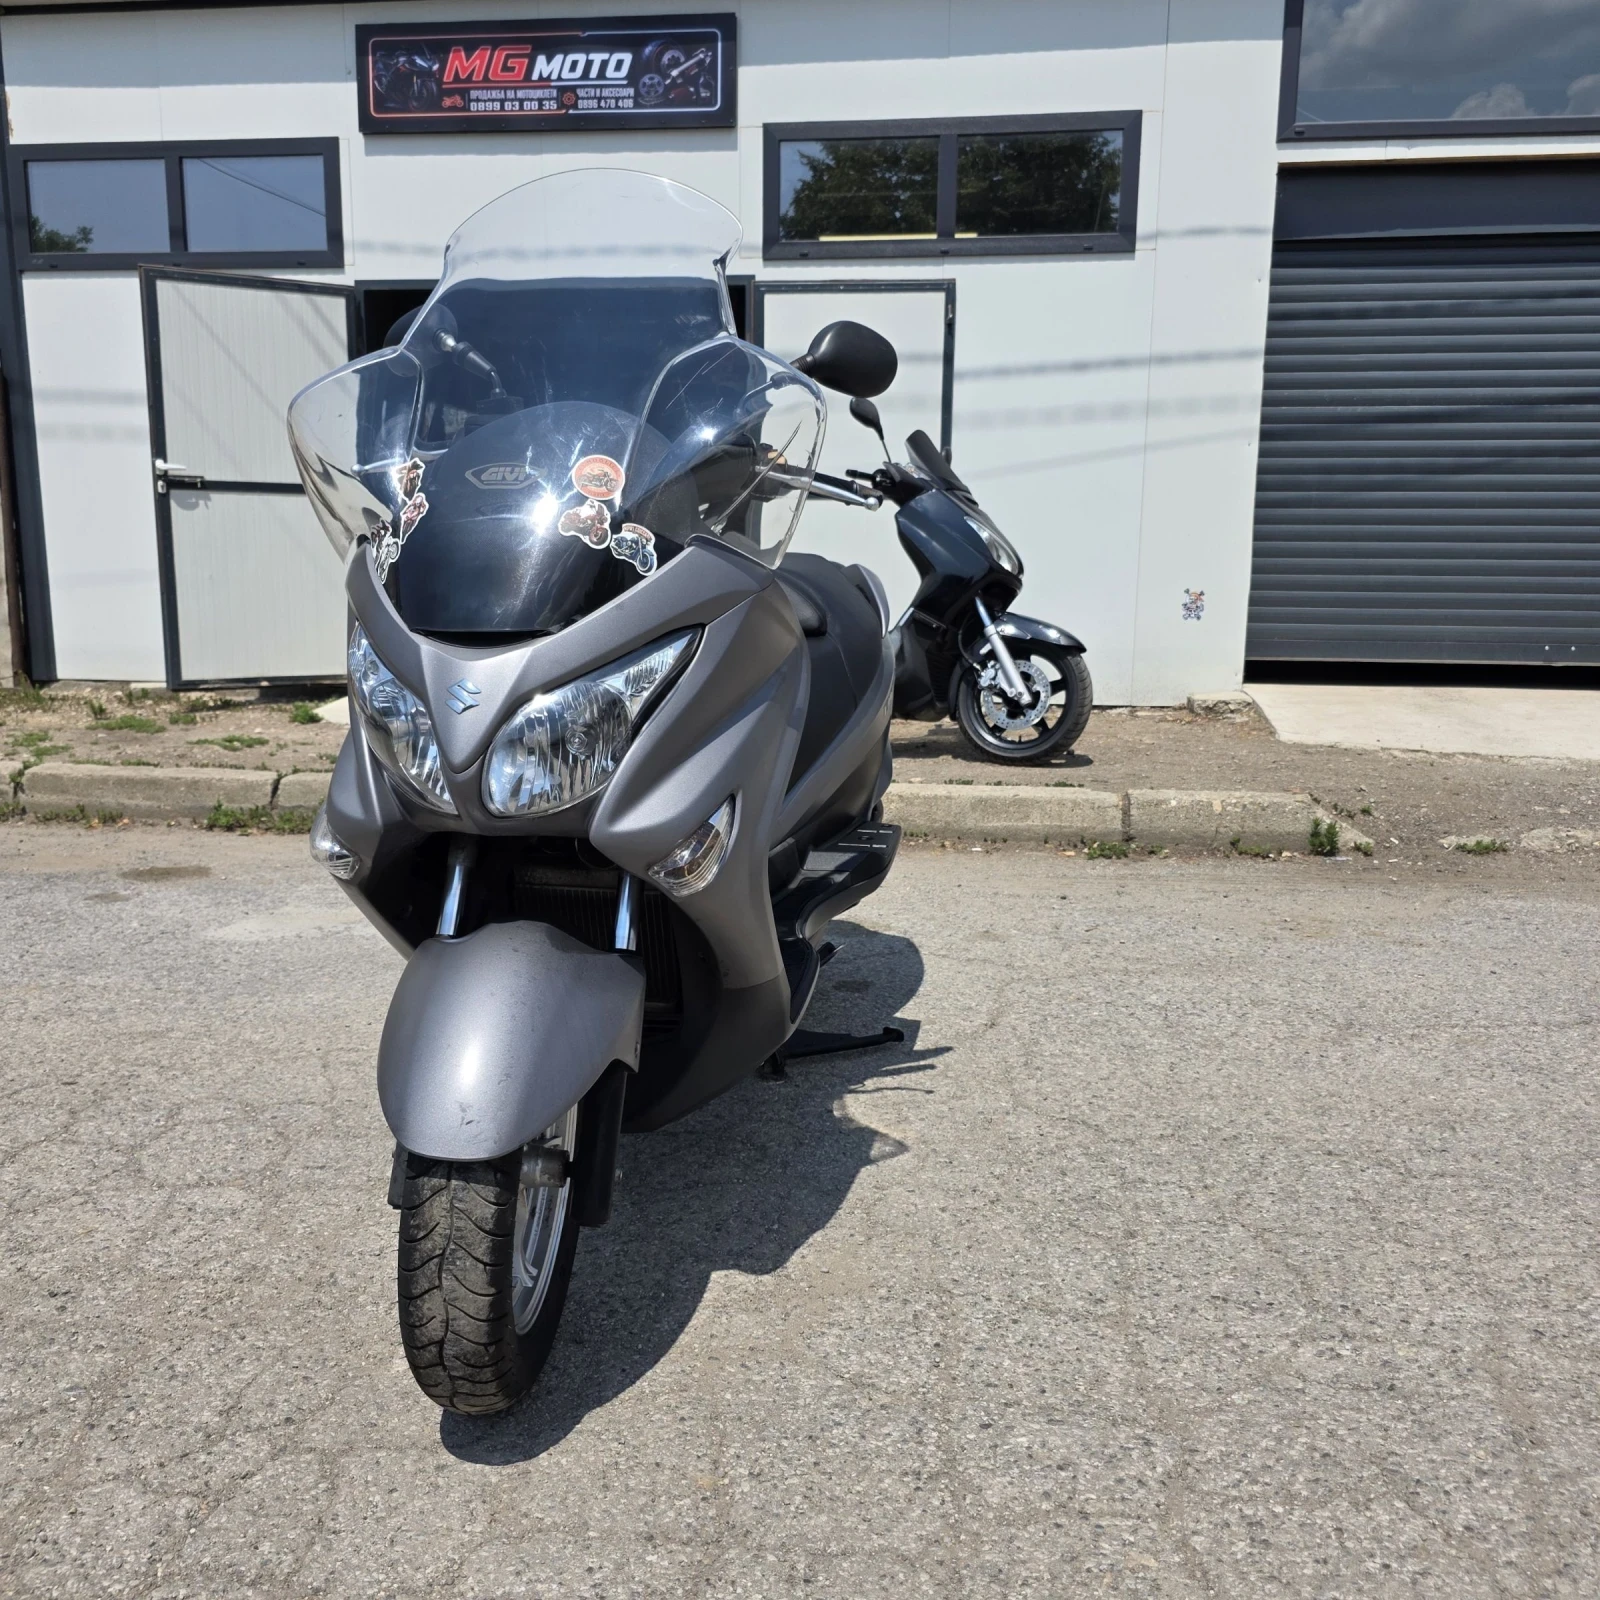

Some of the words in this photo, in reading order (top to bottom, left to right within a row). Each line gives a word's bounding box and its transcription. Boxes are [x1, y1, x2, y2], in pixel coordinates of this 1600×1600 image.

[442, 44, 532, 83] MG
[531, 52, 633, 80] MOTO
[470, 89, 505, 100] ПРОДАЖБА
[506, 89, 515, 99] НА
[516, 88, 557, 99] МОТОЦИКЛЕТИ
[576, 88, 595, 97] ЧАСТИ
[595, 87, 601, 97] И
[470, 101, 501, 111] 0899
[504, 101, 519, 111] 03
[523, 101, 539, 110] 00
[542, 100, 558, 110] 35
[577, 99, 598, 109] 0896
[480, 466, 528, 481] GIVI
